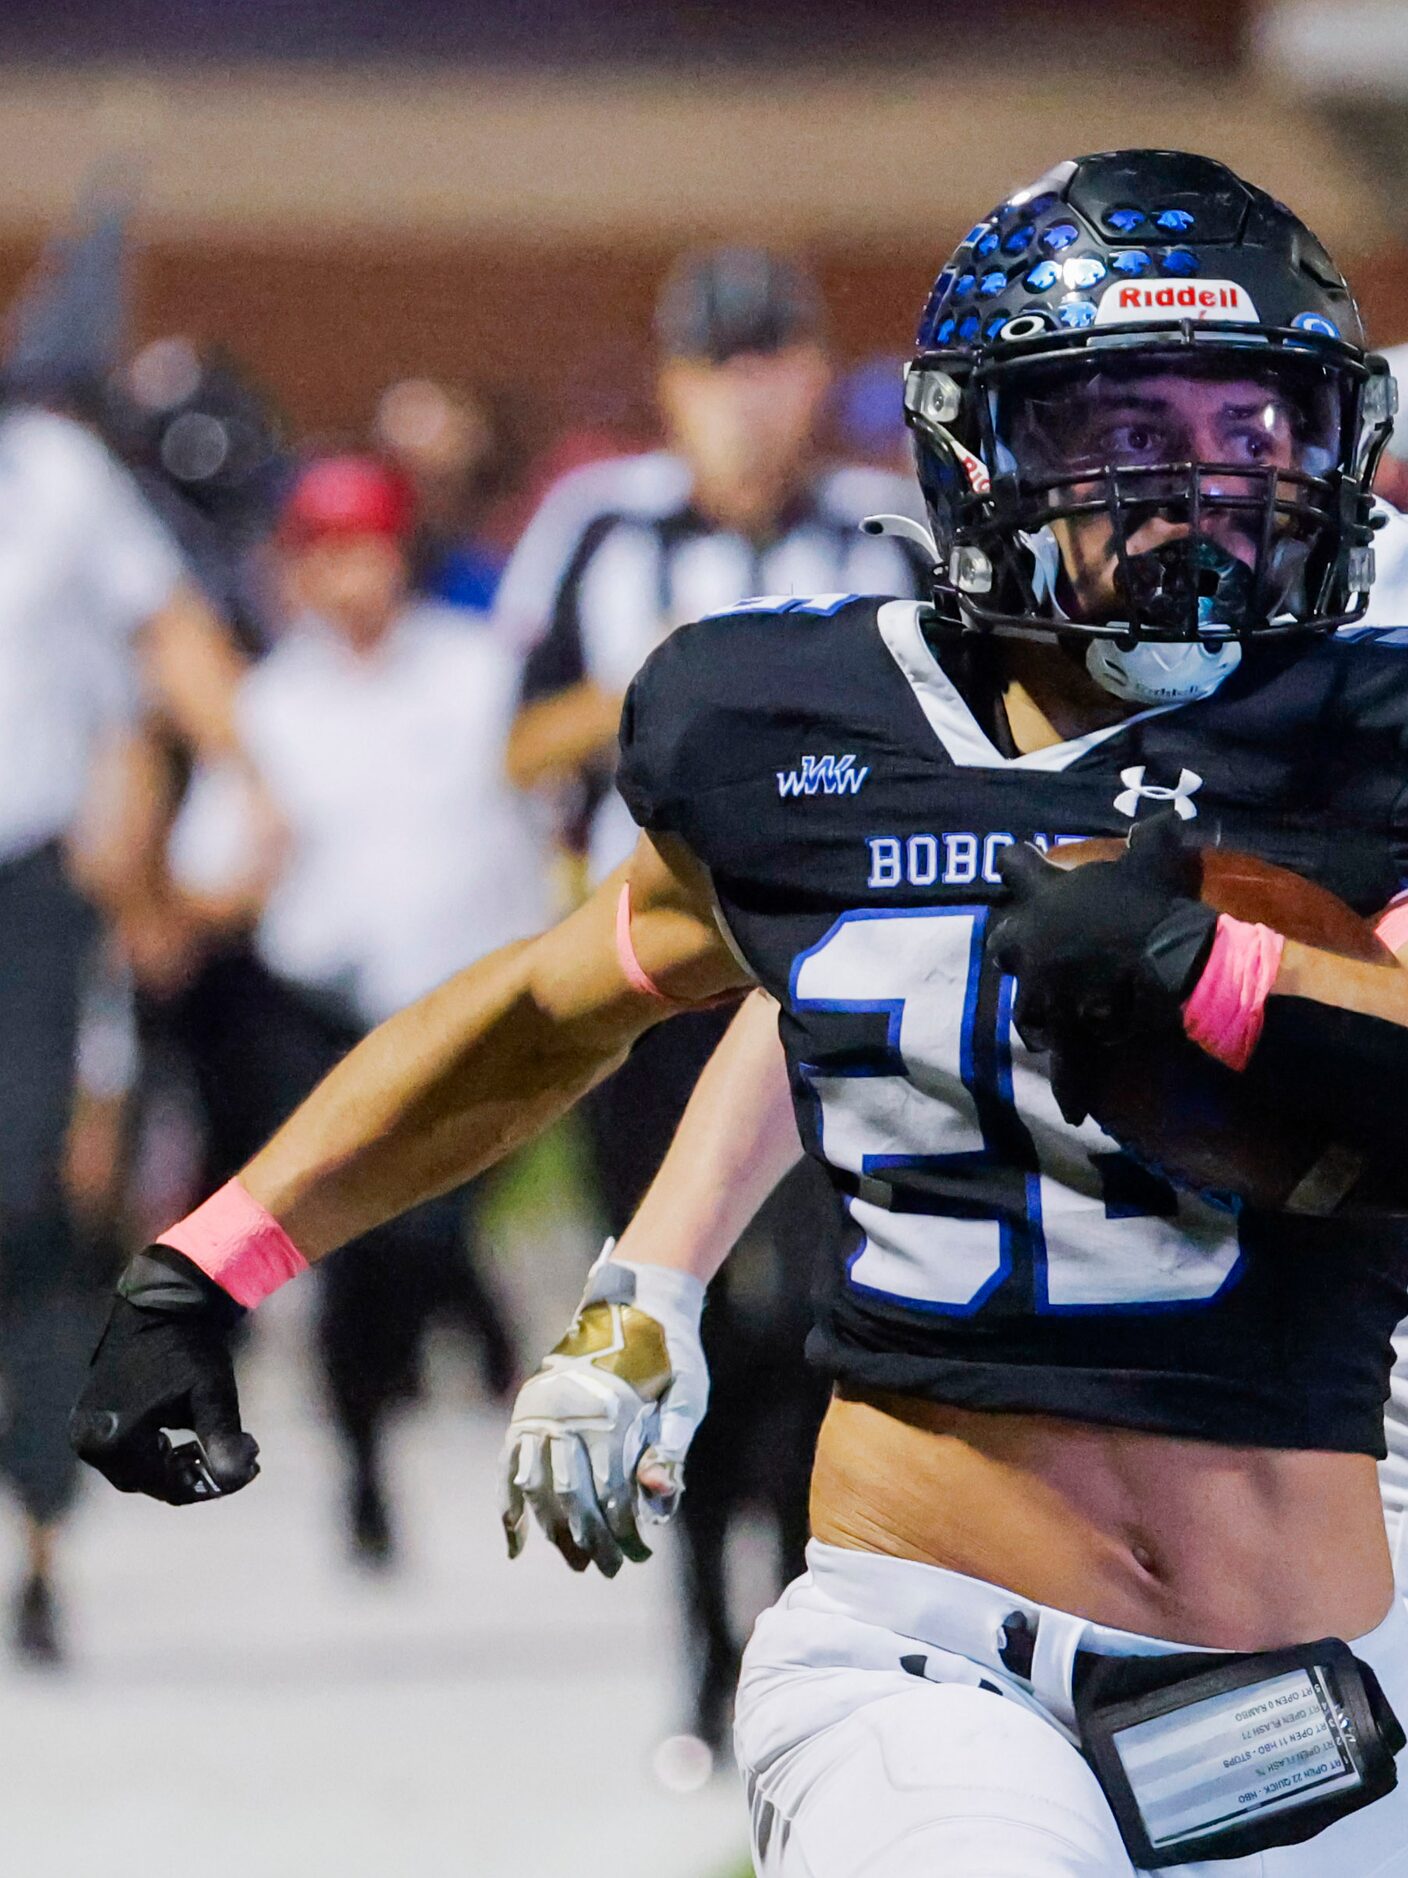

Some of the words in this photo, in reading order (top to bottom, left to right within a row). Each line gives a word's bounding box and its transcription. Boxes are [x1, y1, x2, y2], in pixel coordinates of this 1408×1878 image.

[1119, 286, 1237, 308] Riddell
[1275, 1691, 1300, 1707] OPEN
[1302, 1686, 1313, 1698] RT
[1252, 1718, 1282, 1737] FLASH
[1289, 1727, 1314, 1743] OPEN
[1315, 1722, 1328, 1735] RT
[1279, 1736, 1288, 1747] 11
[1324, 1738, 1337, 1751] RT
[1223, 1751, 1252, 1768] STOPS
[1304, 1764, 1328, 1779] OPEN
[1265, 1777, 1291, 1794] QUICK
[1292, 1775, 1303, 1784] 22
